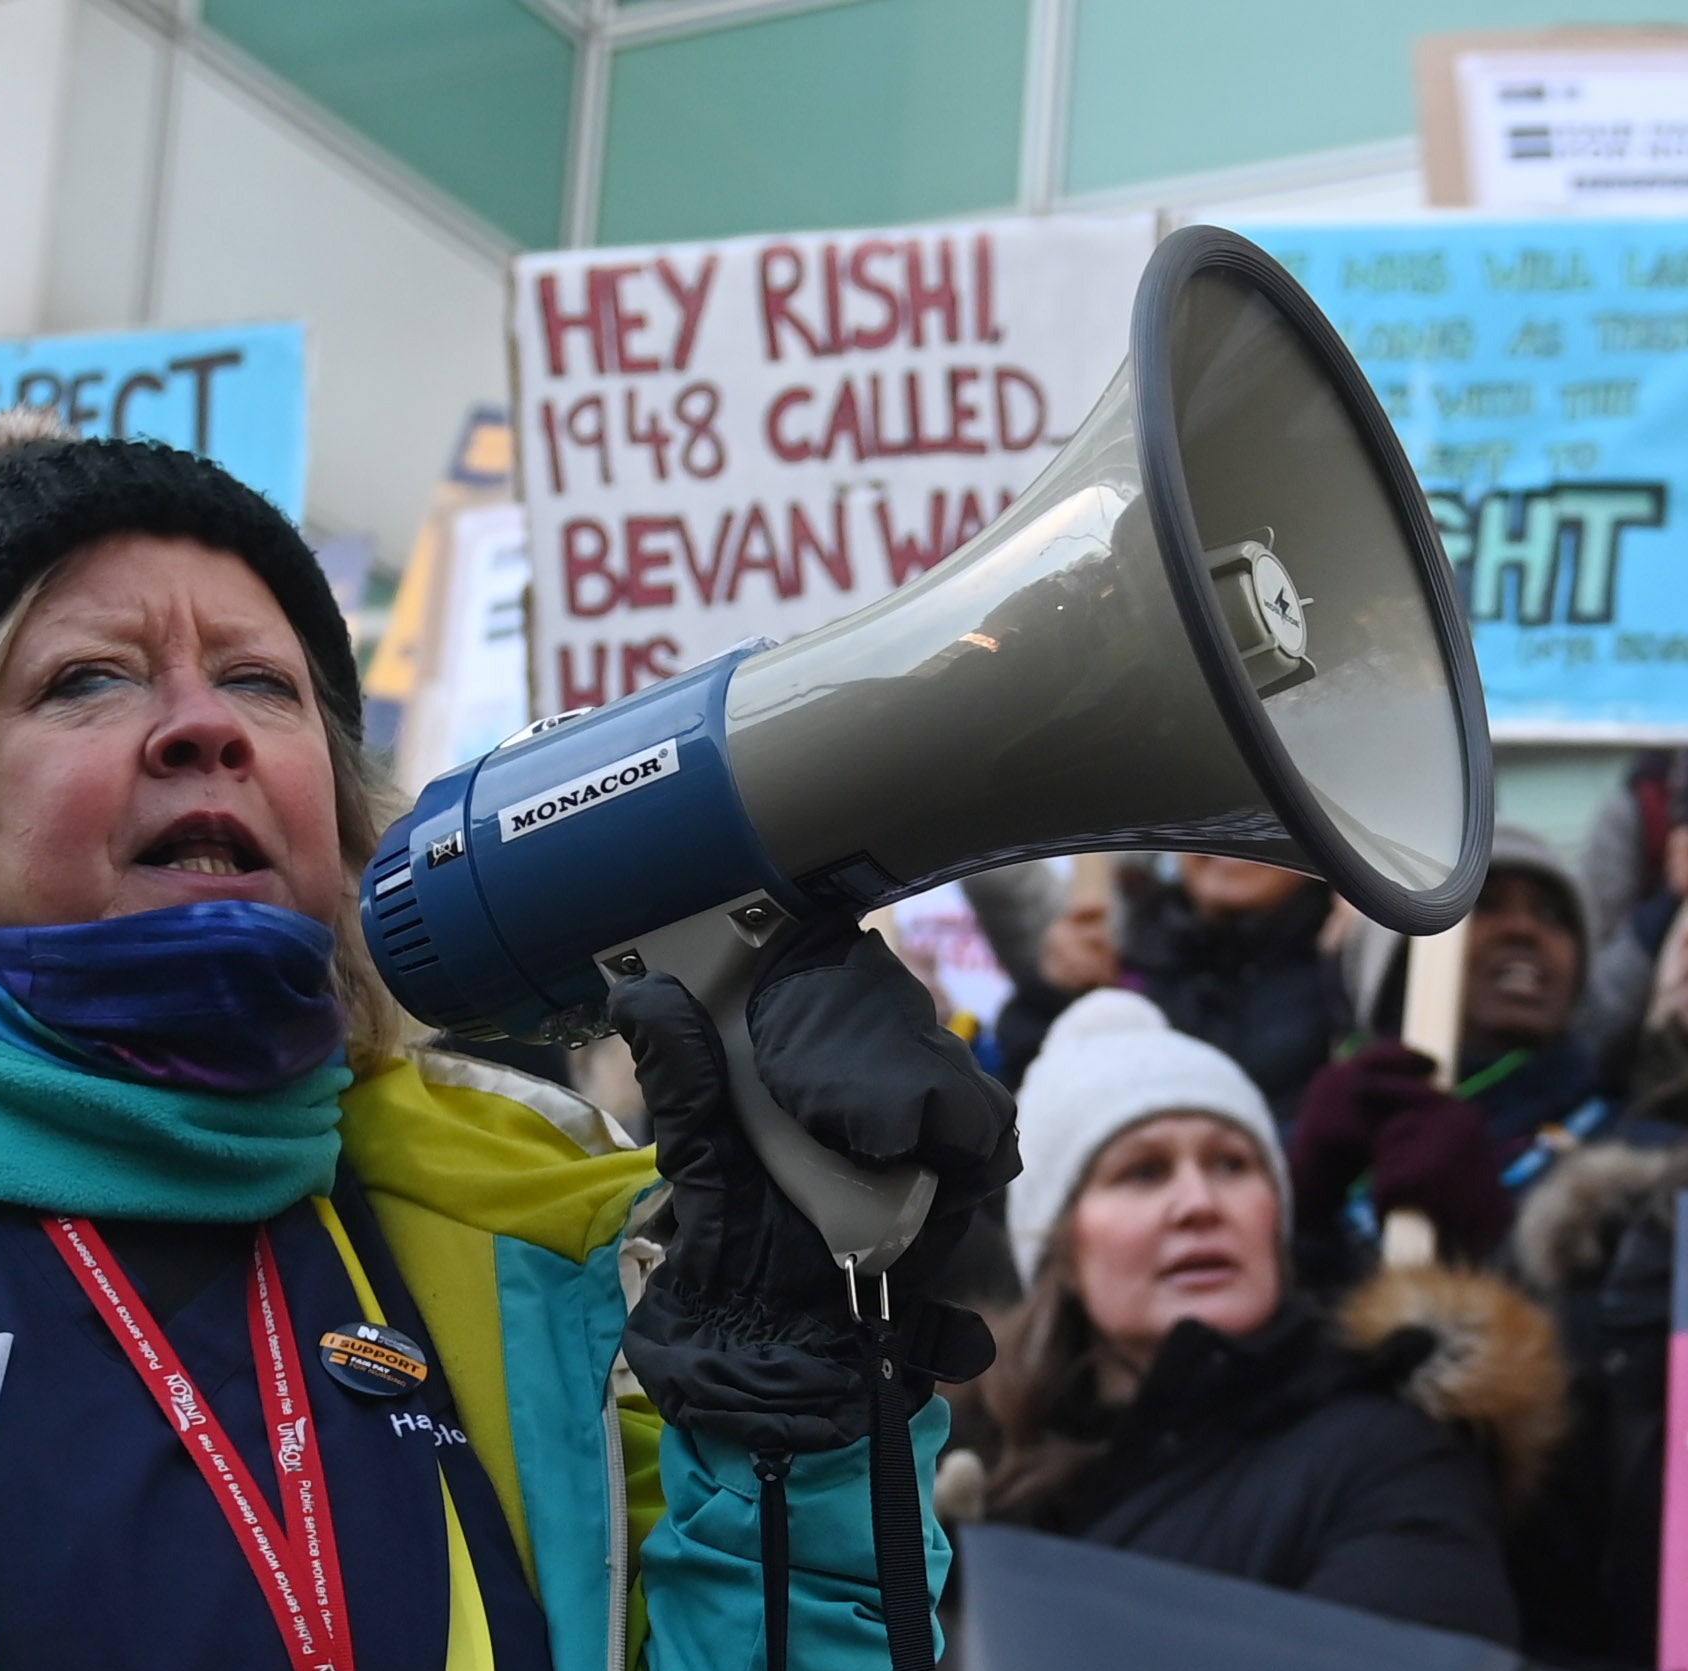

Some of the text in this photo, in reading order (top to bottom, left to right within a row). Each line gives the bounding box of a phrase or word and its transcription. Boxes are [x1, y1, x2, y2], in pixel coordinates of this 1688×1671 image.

[536, 254, 721, 378] HEY
[540, 381, 727, 495] 1948
[560, 489, 1022, 620] BEVAN WA
[67, 1231, 97, 1268] deserve
[92, 1268, 121, 1306] workers
[116, 1305, 144, 1340] service
[138, 1340, 164, 1371] Public
[339, 1338, 422, 1374] SUPPORT
[350, 1356, 391, 1374] FAIR PAY
[163, 1369, 207, 1427] UNISON
[197, 1433, 216, 1454] rise
[211, 1451, 229, 1476] pay
[276, 1421, 304, 1474] UNISON
[227, 1481, 259, 1526] deserve
[252, 1526, 281, 1572] workers
[298, 1479, 330, 1606] Public service workers
[274, 1570, 301, 1614] service
[293, 1614, 315, 1656] Public
